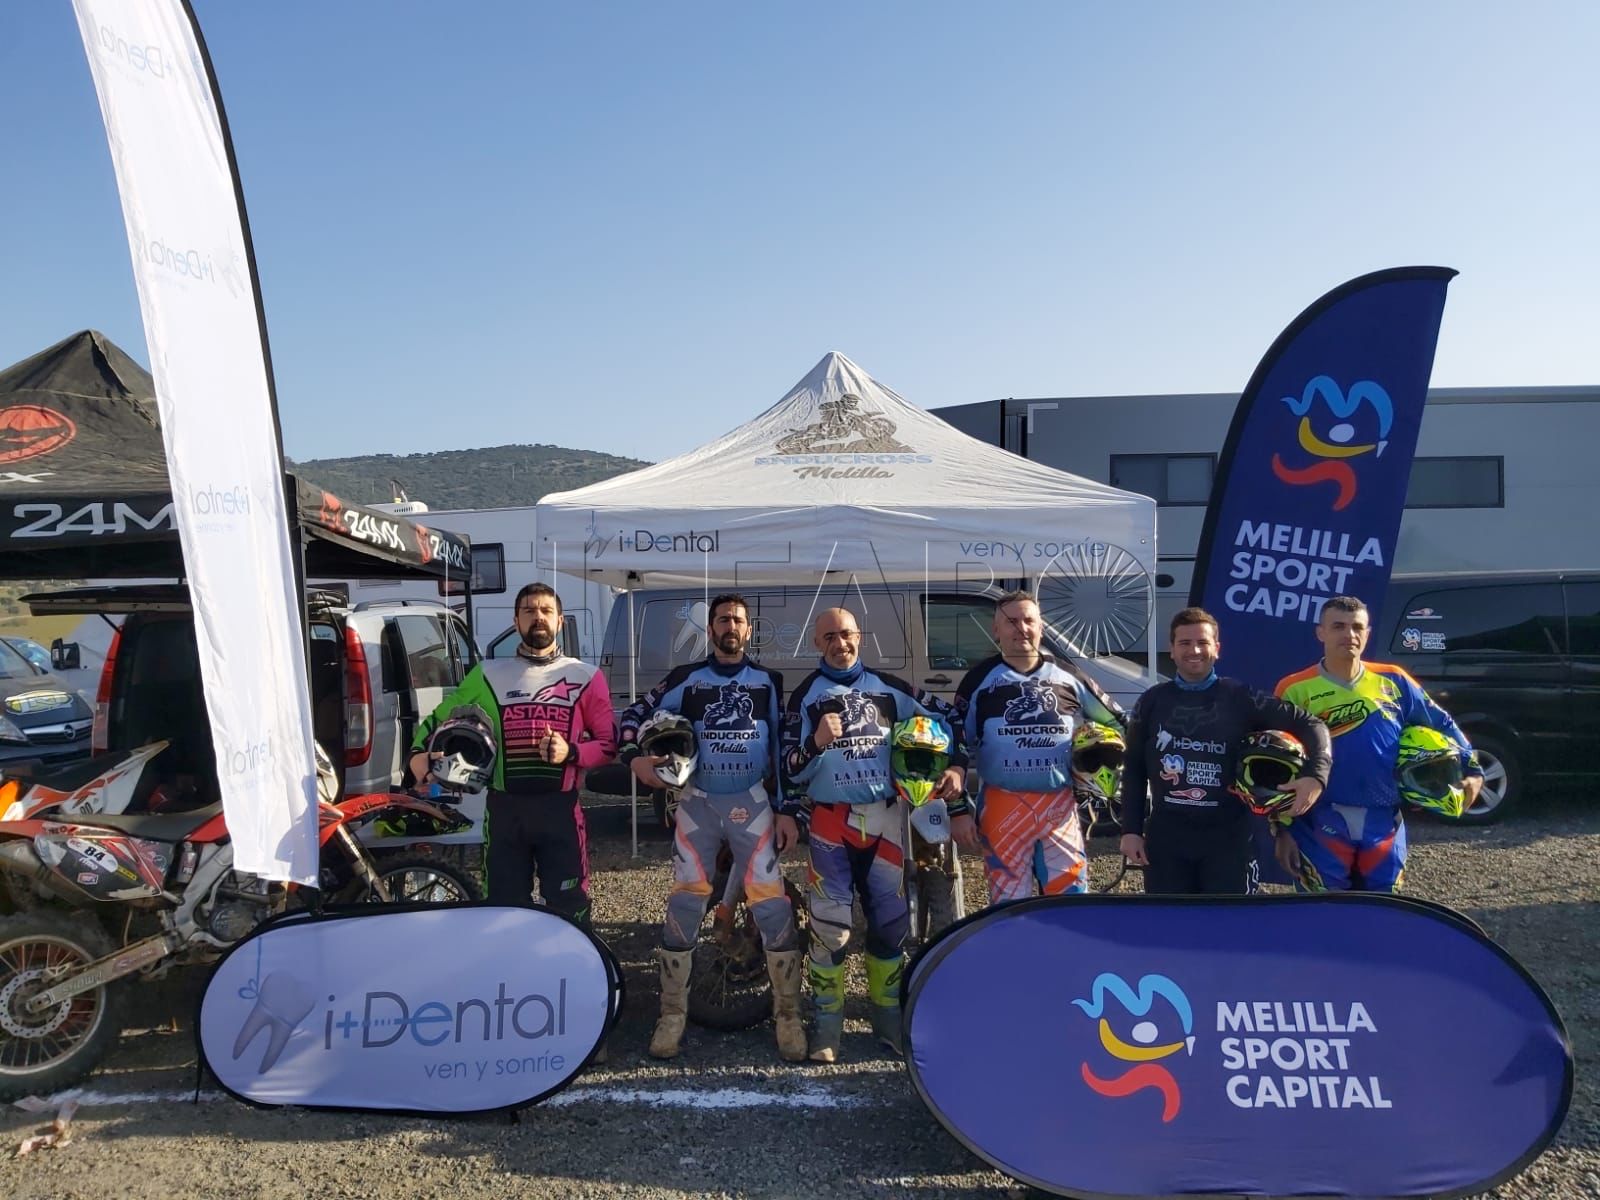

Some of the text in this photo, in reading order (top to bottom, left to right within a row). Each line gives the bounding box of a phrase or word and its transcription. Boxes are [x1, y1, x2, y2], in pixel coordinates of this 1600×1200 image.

[754, 454, 933, 465] ENDUCROSS
[793, 466, 895, 480] Melilla
[10, 502, 178, 538] 24M
[344, 510, 405, 551] 24MX
[619, 529, 719, 553] i+Dental
[1234, 519, 1384, 567] MELILLA
[959, 542, 1004, 557] ven
[1013, 542, 1026, 562] y
[1229, 551, 1353, 594] SPORT
[1224, 583, 1325, 624] CAPIT
[503, 704, 570, 721] ASTARS
[700, 731, 760, 741] ENDUCROSS
[998, 726, 1069, 736] ENDUCROSS
[826, 736, 888, 750] ENDUCROSS
[1015, 737, 1057, 748] Melilla
[1187, 761, 1222, 772] MELILLA
[1187, 769, 1216, 779] SPORT
[1186, 777, 1221, 786] CAPITAL
[84, 846, 105, 862] 84
[325, 978, 567, 1050] i+Dental
[1216, 1001, 1377, 1033] MELILLA
[1220, 1037, 1351, 1070] SPORT
[424, 1050, 565, 1082] ven y sonríe
[1226, 1075, 1392, 1109] CAPITAL
